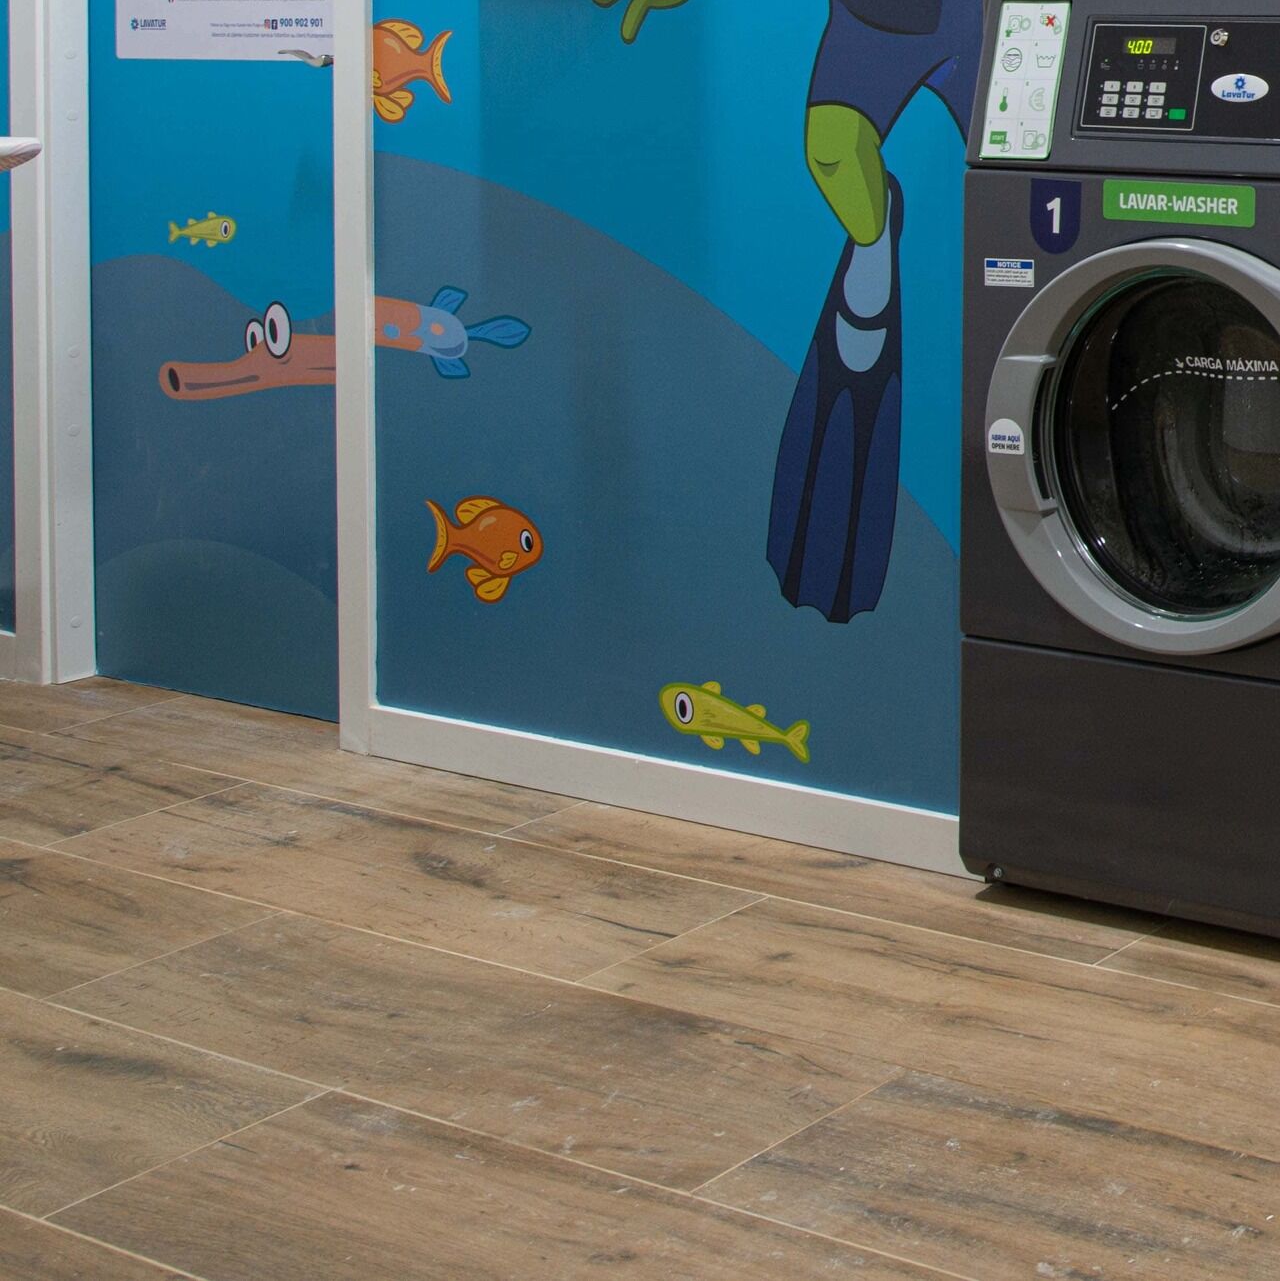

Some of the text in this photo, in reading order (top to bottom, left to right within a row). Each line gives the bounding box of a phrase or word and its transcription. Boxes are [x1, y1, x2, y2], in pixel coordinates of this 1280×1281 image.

[140, 18, 323, 28] LAVATUR 900 902 901
[1128, 40, 1153, 55] 4.00
[1221, 89, 1256, 100] LavaTur
[1119, 192, 1239, 215] LAVAR-WASHER
[1045, 197, 1062, 234] 1
[1186, 356, 1279, 372] CARGA MÁXIMA
